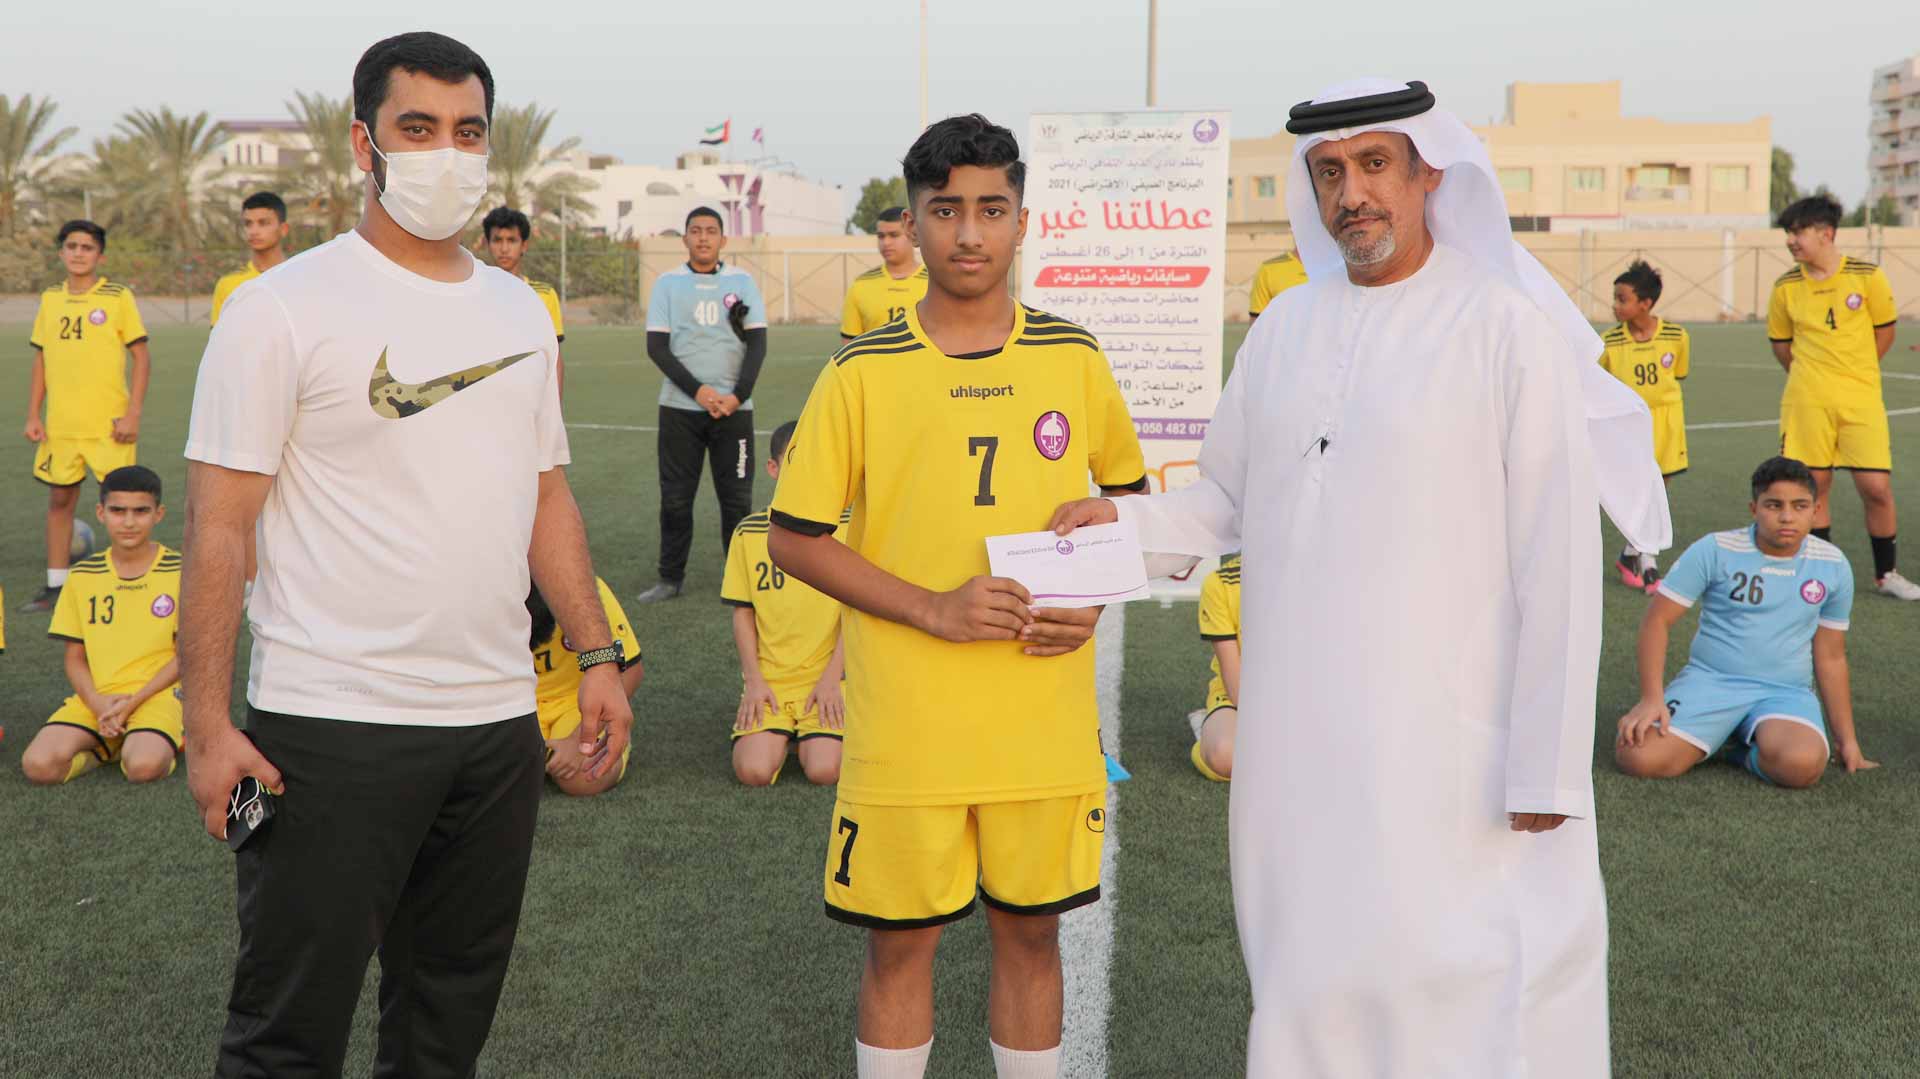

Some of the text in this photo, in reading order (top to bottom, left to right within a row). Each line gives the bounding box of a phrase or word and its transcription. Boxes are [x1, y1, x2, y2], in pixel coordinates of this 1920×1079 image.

[1048, 179, 1070, 189] 2021
[1039, 198, 1213, 240] عطلتنا غير
[1095, 246, 1110, 257] 26
[1138, 245, 1145, 257] 1
[1149, 248, 1166, 260] من
[1053, 267, 1191, 286] مسابقات رياضية متنوعة
[694, 301, 719, 326] 40
[1143, 312, 1199, 326] مسابقات
[1825, 306, 1837, 331] 4
[60, 315, 82, 340] 24
[1634, 362, 1659, 387] 98
[950, 384, 1015, 401] uhlsport
[968, 436, 999, 506] 7
[755, 561, 785, 592] 26
[1729, 571, 1765, 606] 26
[88, 594, 115, 625] 13
[833, 815, 859, 888] 7
